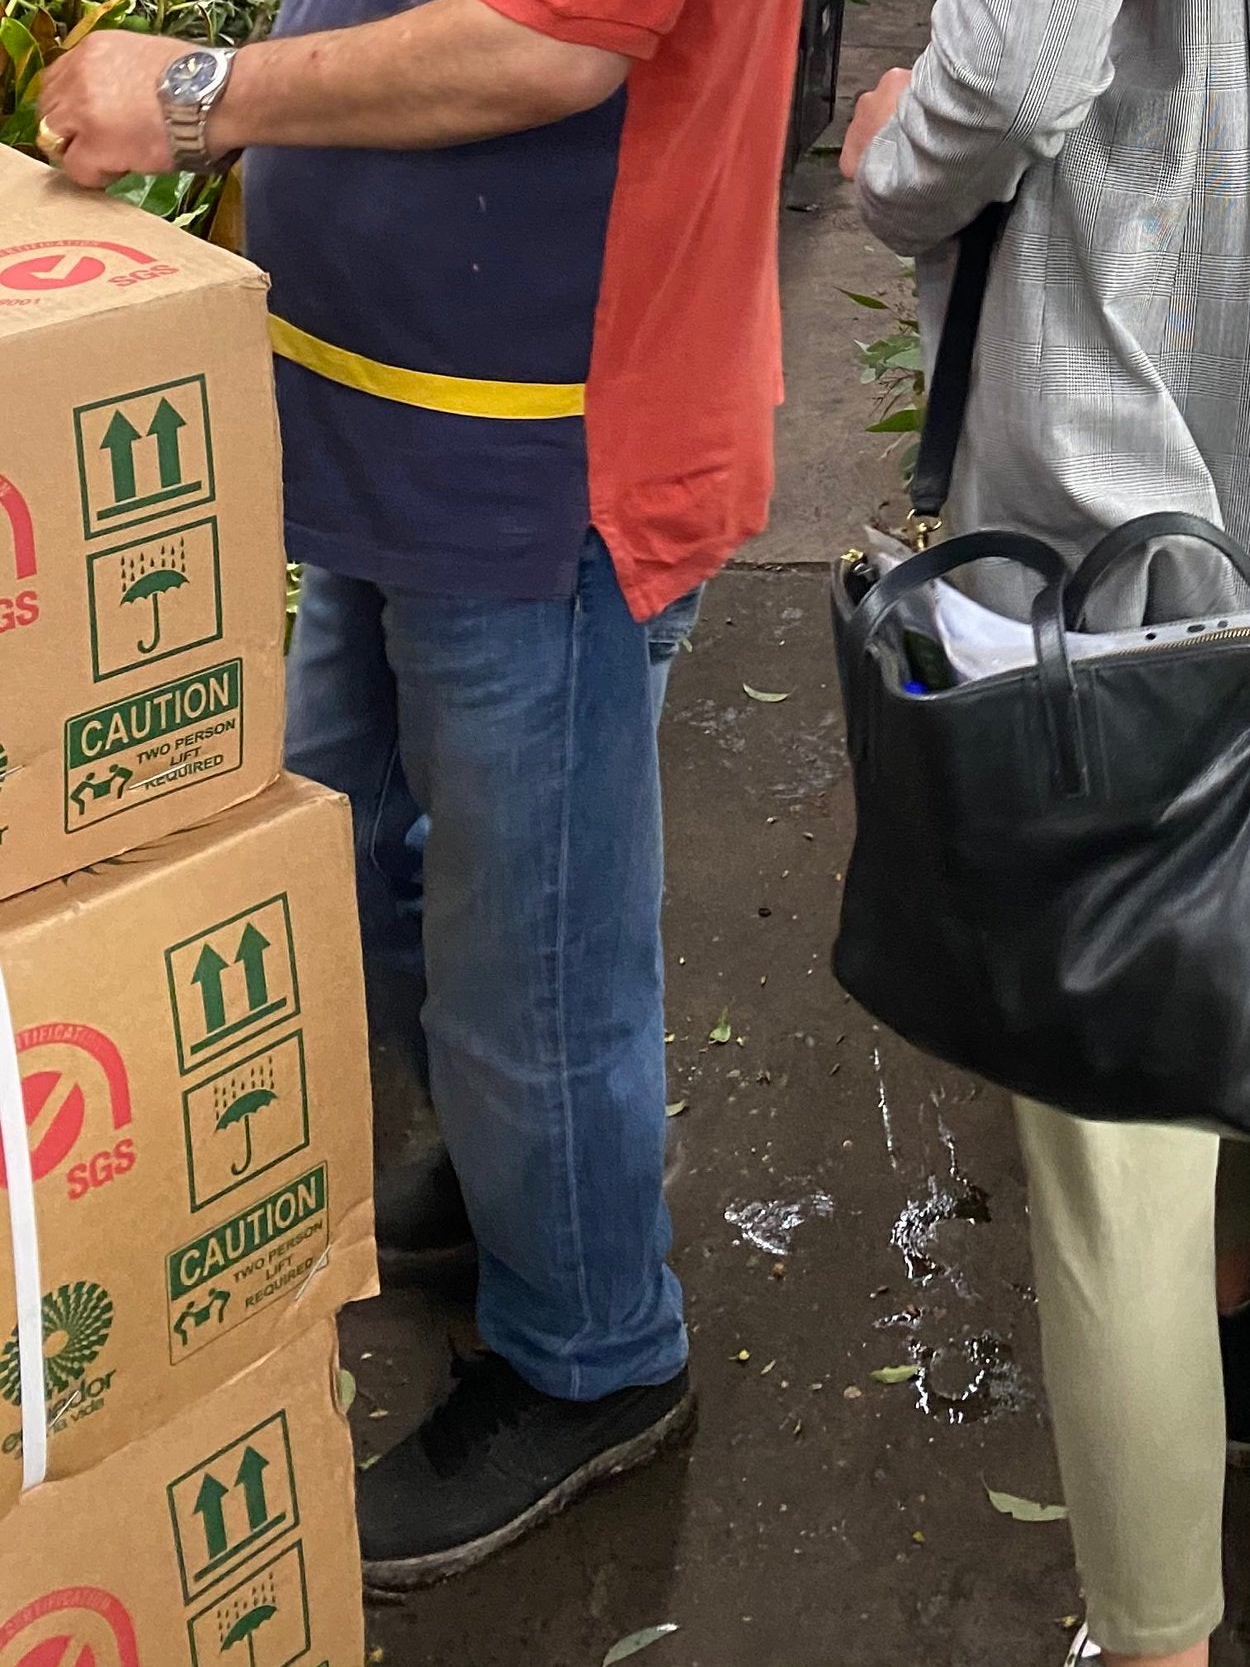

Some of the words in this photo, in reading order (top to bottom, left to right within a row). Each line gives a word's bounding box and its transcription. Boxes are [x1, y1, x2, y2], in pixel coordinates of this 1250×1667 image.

[108, 264, 179, 287] SGS
[81, 672, 230, 757] CAUTION
[136, 743, 171, 765] TWO
[174, 718, 236, 751] PERSON
[170, 746, 202, 766] LIFT
[67, 1138, 137, 1200] SGS
[180, 1176, 316, 1286] CAUTION
[232, 1258, 265, 1283] TWO
[268, 1219, 323, 1261] PERSON
[245, 1257, 314, 1308] REQUIRED
[265, 1253, 294, 1280] LIFT
